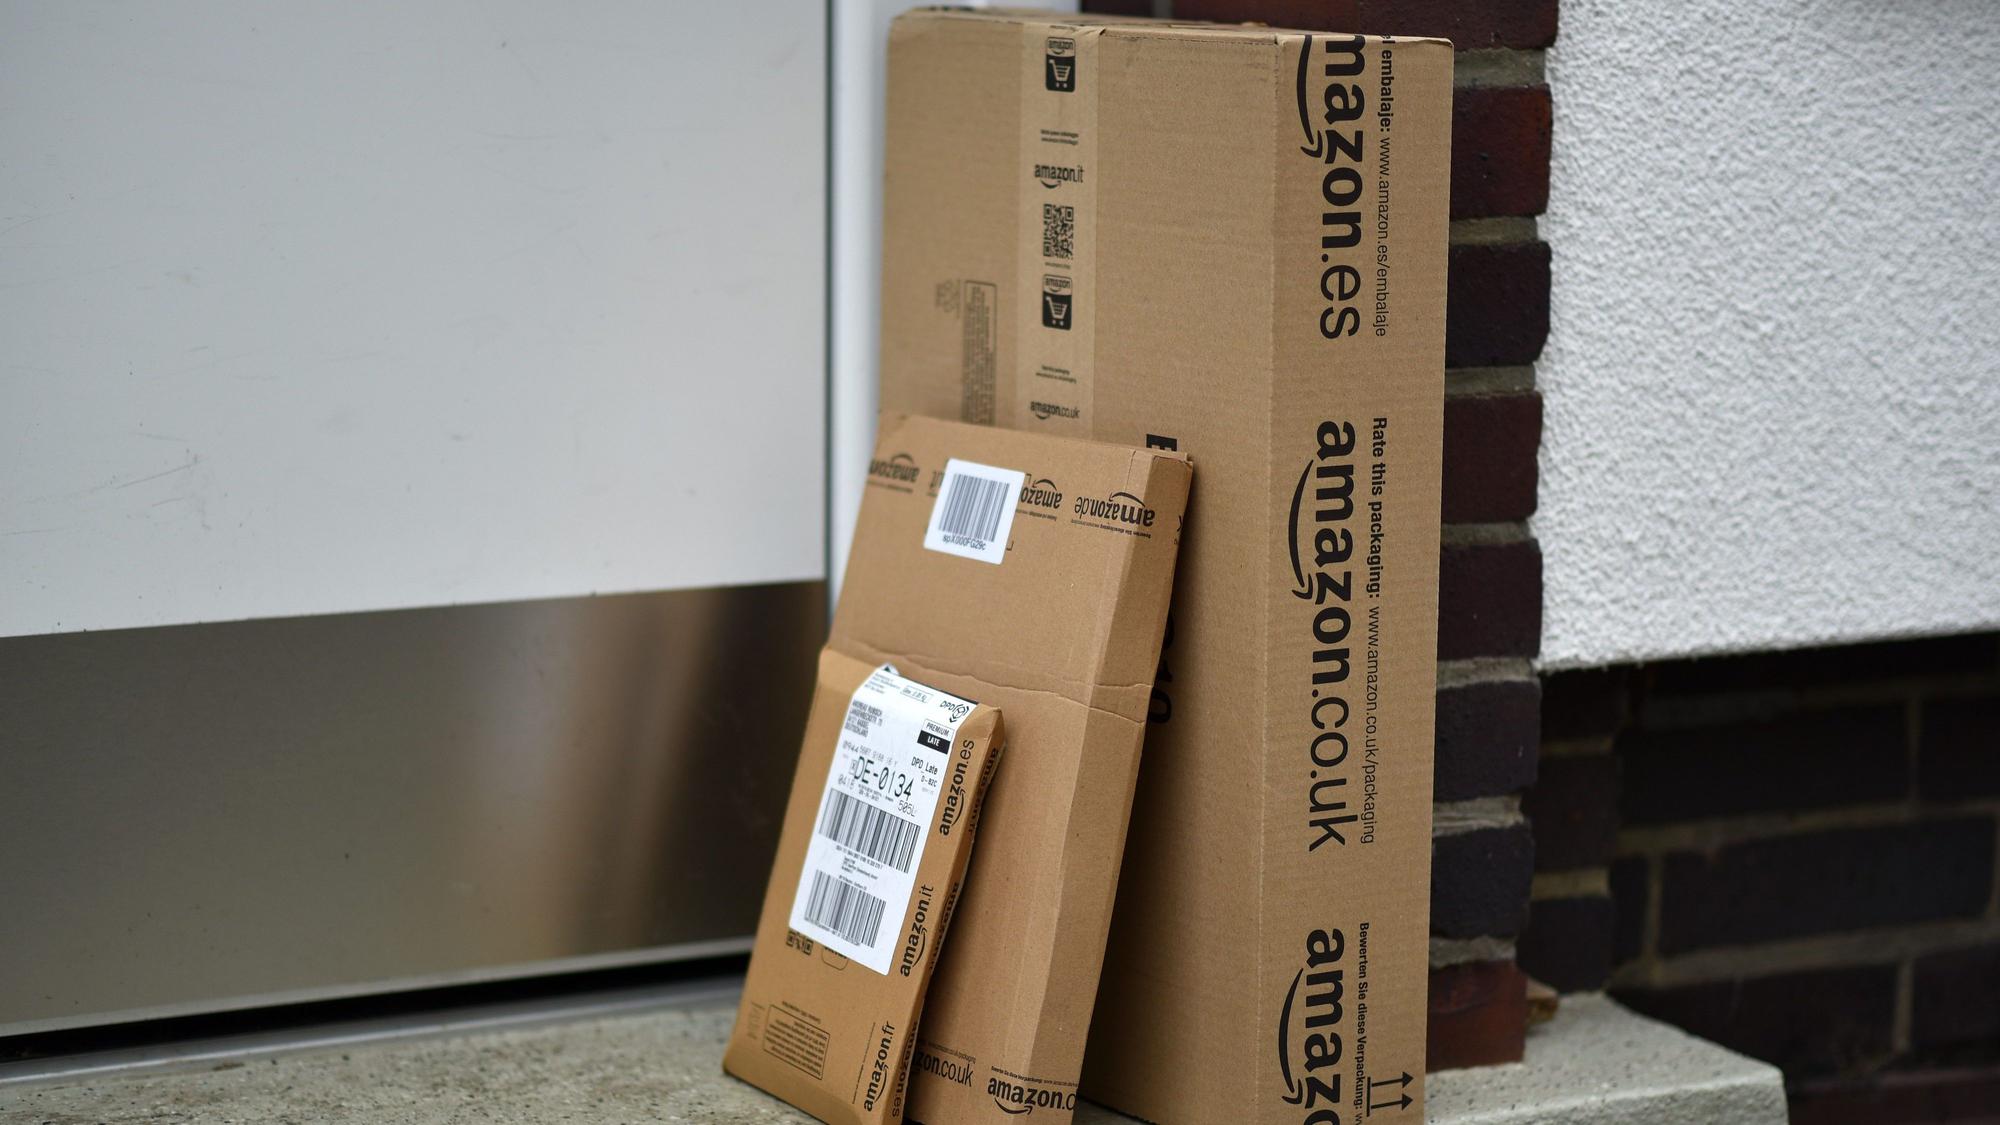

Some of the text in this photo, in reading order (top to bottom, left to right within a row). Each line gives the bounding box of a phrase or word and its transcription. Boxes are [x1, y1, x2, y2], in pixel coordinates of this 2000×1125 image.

[1378, 50, 1395, 132] embalaje:
[1034, 164, 1084, 183] amazon.it
[1320, 34, 1366, 340] mazon.es
[1373, 137, 1391, 337] www.amazon.es/embalaje
[1021, 487, 1063, 510] amazo
[1074, 496, 1156, 527] amazon.de
[1309, 421, 1358, 852] amazon.co.uk
[1360, 417, 1388, 844] Rate this packaging: www.amazon.co.uk/packaging
[926, 721, 950, 737] PREMIUM
[927, 735, 941, 747] LATE
[940, 740, 974, 836] amazon.es
[900, 884, 934, 977] amazon.it
[1358, 922, 1370, 979] Bewerten
[1357, 1003, 1368, 1035] diese
[1358, 980, 1368, 1000] Sie
[864, 1021, 896, 1112] amazon.fr
[1353, 1036, 1367, 1109] Verpackung:
